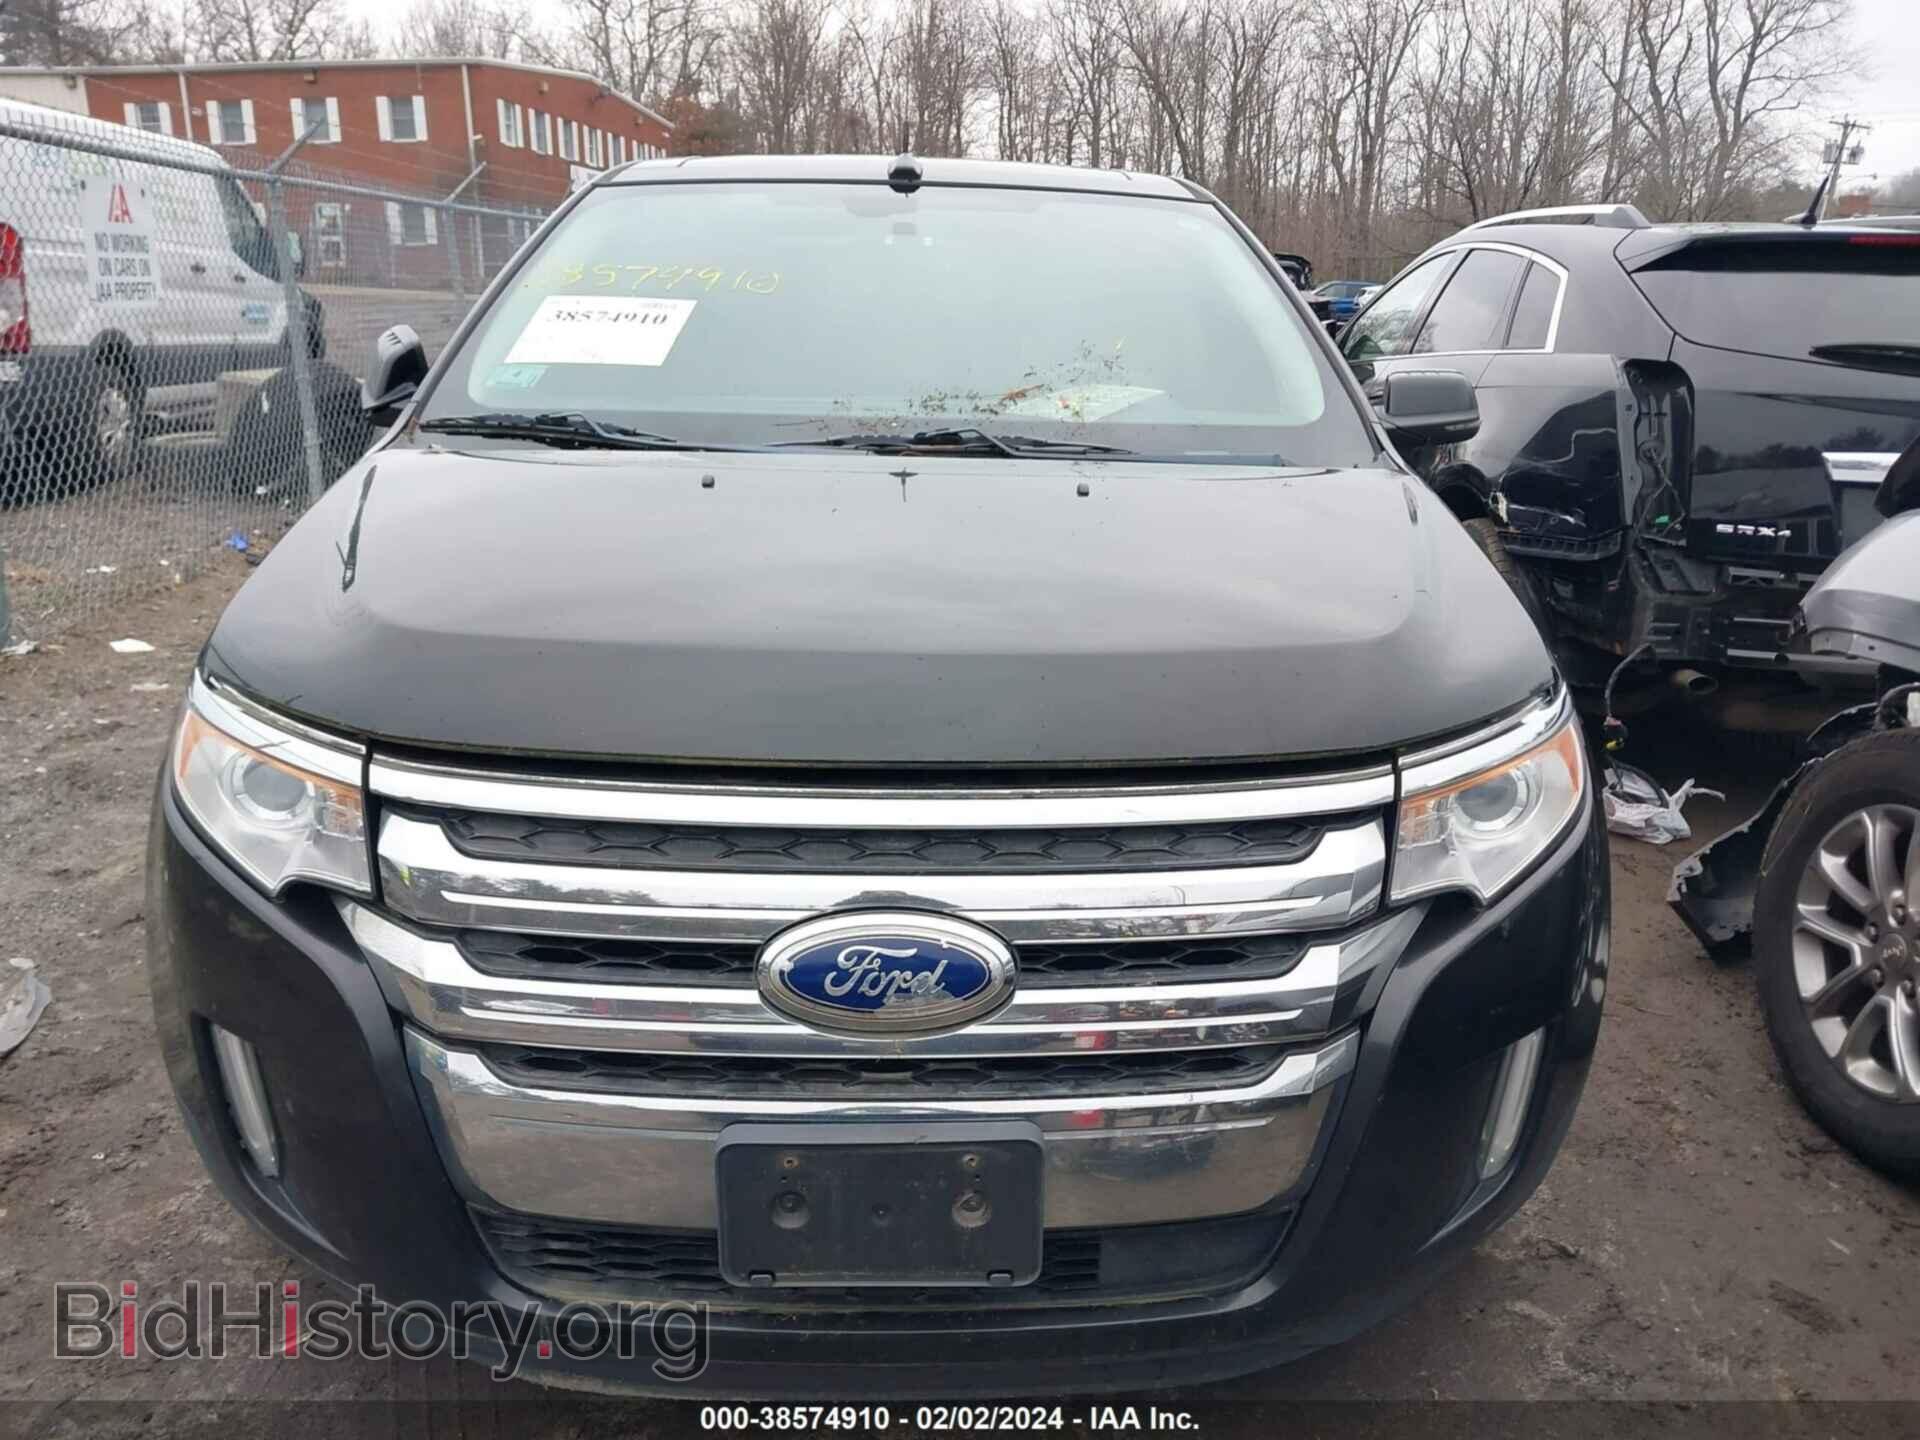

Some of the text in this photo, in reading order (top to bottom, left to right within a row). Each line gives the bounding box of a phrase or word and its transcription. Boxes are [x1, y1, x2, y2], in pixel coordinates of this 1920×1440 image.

[94, 232, 149, 254] NO WORKING
[98, 257, 151, 276] ON CARS ON
[96, 282, 156, 302] IAA PROPERTY
[549, 310, 669, 326] 38574910
[824, 945, 949, 1000] Ford
